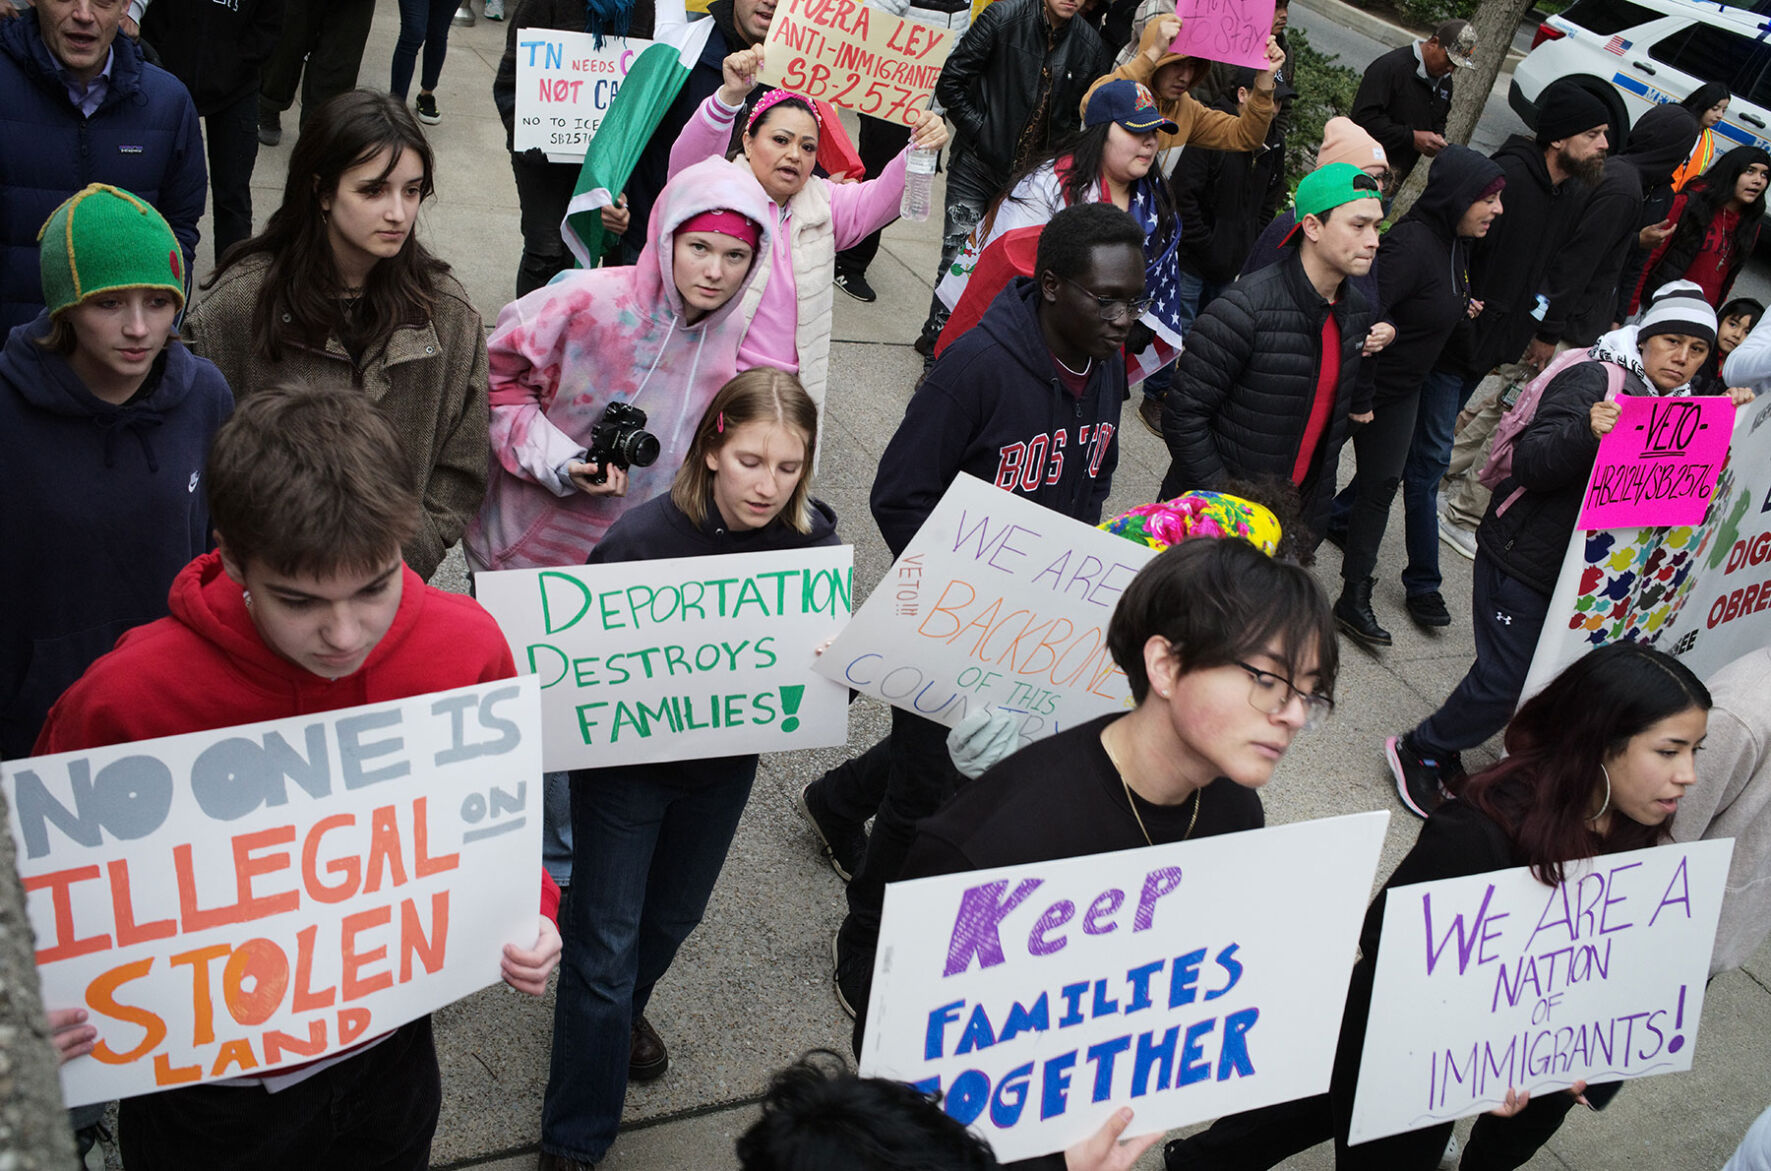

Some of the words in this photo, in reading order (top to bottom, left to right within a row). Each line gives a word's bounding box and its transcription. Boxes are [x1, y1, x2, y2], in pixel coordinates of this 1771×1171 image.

[520, 41, 562, 69] TN
[572, 59, 615, 73] NEEDS
[886, 20, 944, 59] LEY
[522, 117, 541, 126] NO
[550, 117, 566, 127] TO
[575, 118, 599, 131] ICE
[594, 79, 618, 110] CA
[781, 57, 930, 126] SB-2576
[995, 422, 1116, 492] BOSO
[953, 510, 1042, 574] WE
[1031, 550, 1139, 607] ARE
[1724, 532, 1771, 576] DIG
[538, 566, 852, 636] DEPORTATION
[1707, 579, 1771, 629] OBRE
[527, 637, 777, 689] DESTROYS
[918, 580, 1129, 700] BACKBONE
[575, 685, 805, 745] FAMILIES!
[846, 654, 1059, 744] COUNR
[957, 667, 1003, 693] OF
[1005, 681, 1062, 715] THIS
[13, 754, 173, 860] NO
[190, 708, 411, 821] ONE
[430, 685, 522, 767] IS
[22, 796, 460, 965] ILLEGAL
[460, 781, 527, 825] ON
[1422, 884, 1510, 976] WE
[1524, 862, 1643, 953] ARE
[1649, 855, 1691, 927] A
[85, 890, 450, 1065] STOLEN
[924, 942, 1244, 1061] FAMILIES
[1492, 938, 1611, 1013] NATION
[1531, 993, 1564, 1026] OF
[153, 1007, 372, 1087] LAND
[1429, 985, 1686, 1110] IMMIGRANTS!
